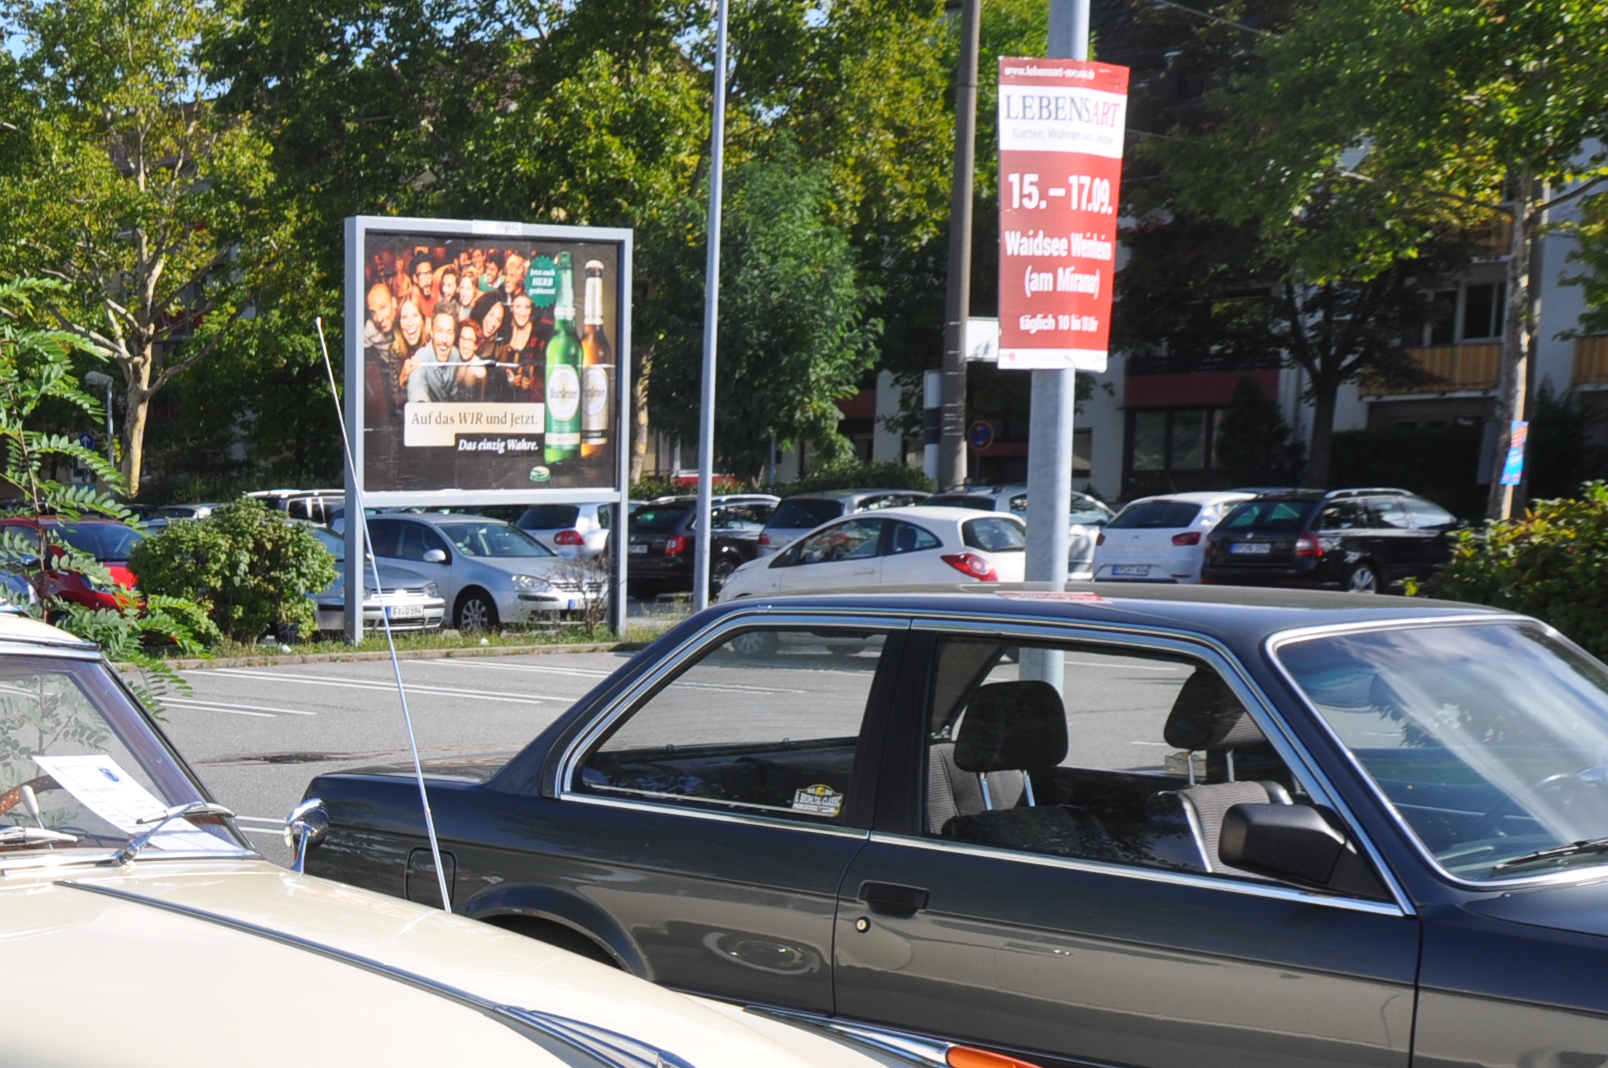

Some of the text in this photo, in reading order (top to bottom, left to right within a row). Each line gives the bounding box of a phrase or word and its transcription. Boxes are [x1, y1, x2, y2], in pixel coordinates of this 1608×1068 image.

[1004, 94, 1121, 128] LEBENSART
[1012, 127, 1046, 140] Garten,
[1047, 128, 1081, 140] Wohnen
[1004, 229, 1112, 261] Waidsee Weinheim
[531, 277, 554, 287] HERB
[1024, 264, 1054, 298] (am
[1019, 313, 1056, 335] täglich
[1057, 314, 1070, 331] 10
[411, 412, 539, 428] Auf das WIR und Jetzt.
[458, 439, 539, 454] Das einzig Wahre.
